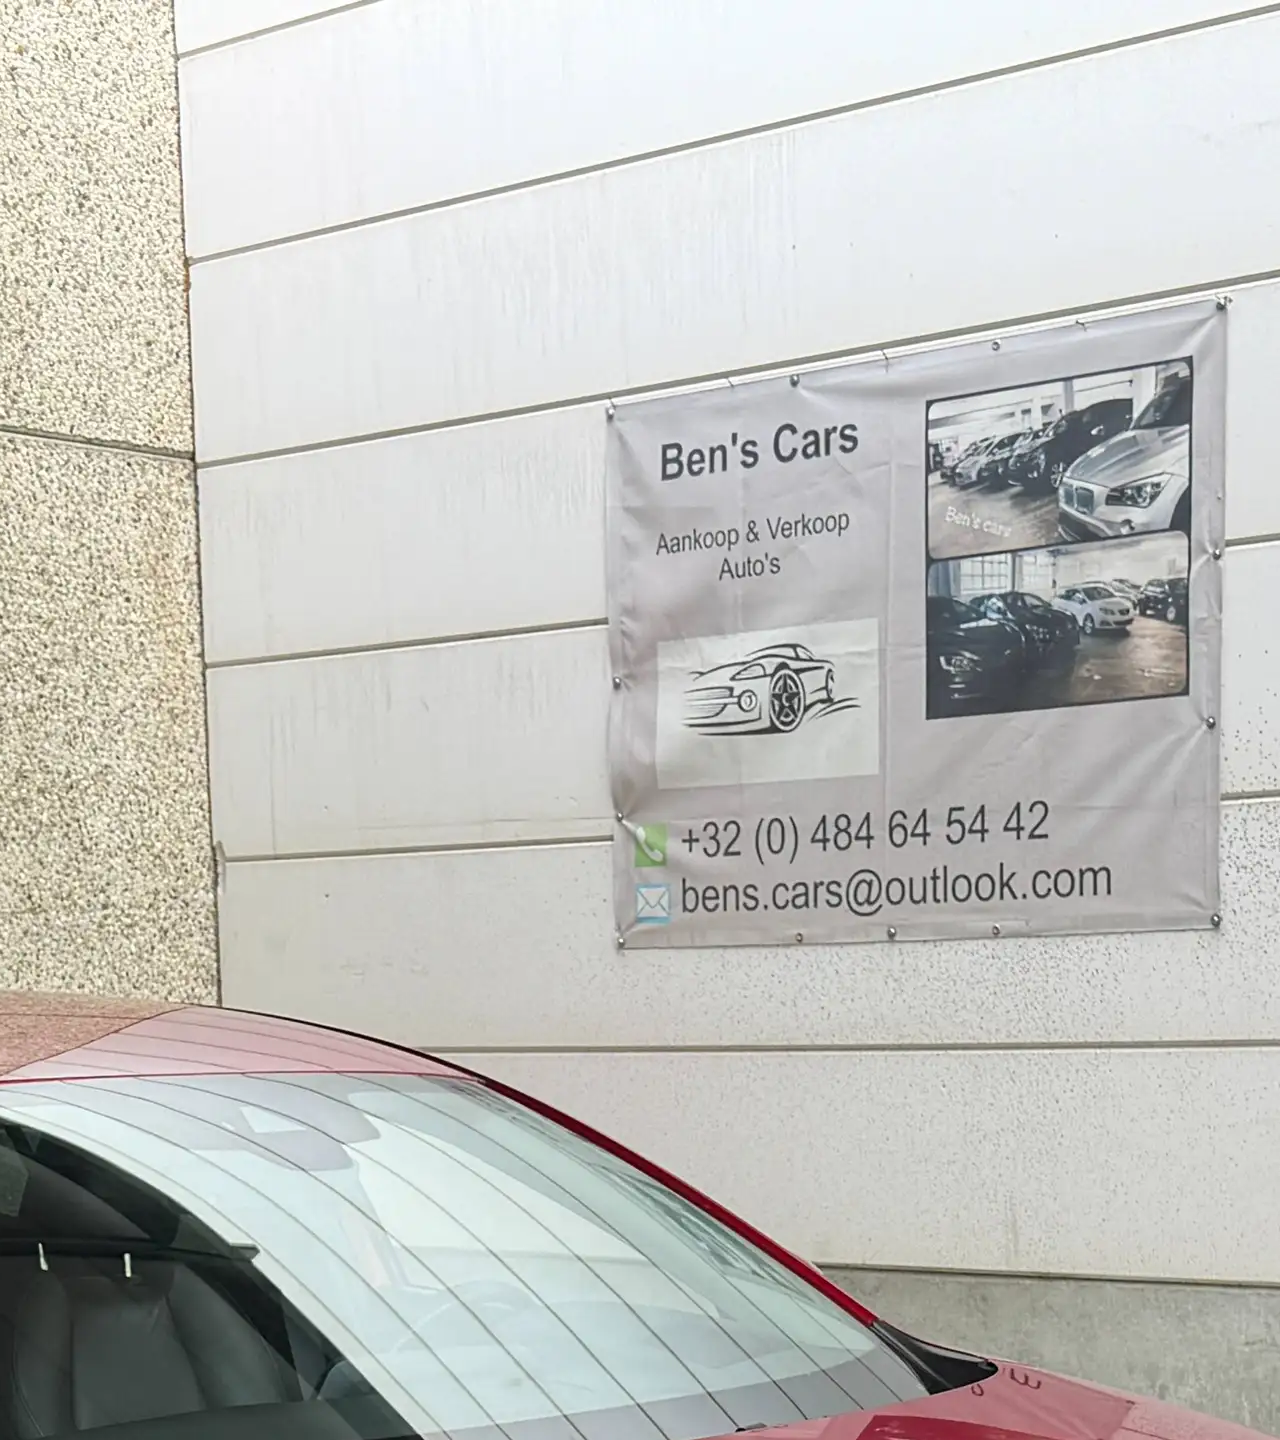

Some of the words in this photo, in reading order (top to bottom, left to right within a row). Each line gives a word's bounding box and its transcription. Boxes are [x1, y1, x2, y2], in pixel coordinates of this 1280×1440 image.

[661, 432, 759, 481] Ben's
[773, 422, 859, 463] Cars
[655, 528, 740, 556] Aankoop
[745, 519, 760, 544] &
[766, 512, 850, 540] Verkoop
[718, 551, 781, 581] Auto's
[681, 820, 742, 858] +32
[755, 816, 799, 866] (0)
[810, 811, 875, 852] 484
[888, 808, 932, 849] 64
[945, 804, 990, 845] 54
[1002, 800, 1049, 841] 42
[681, 862, 1113, 917] bens.cars@outlook.com
